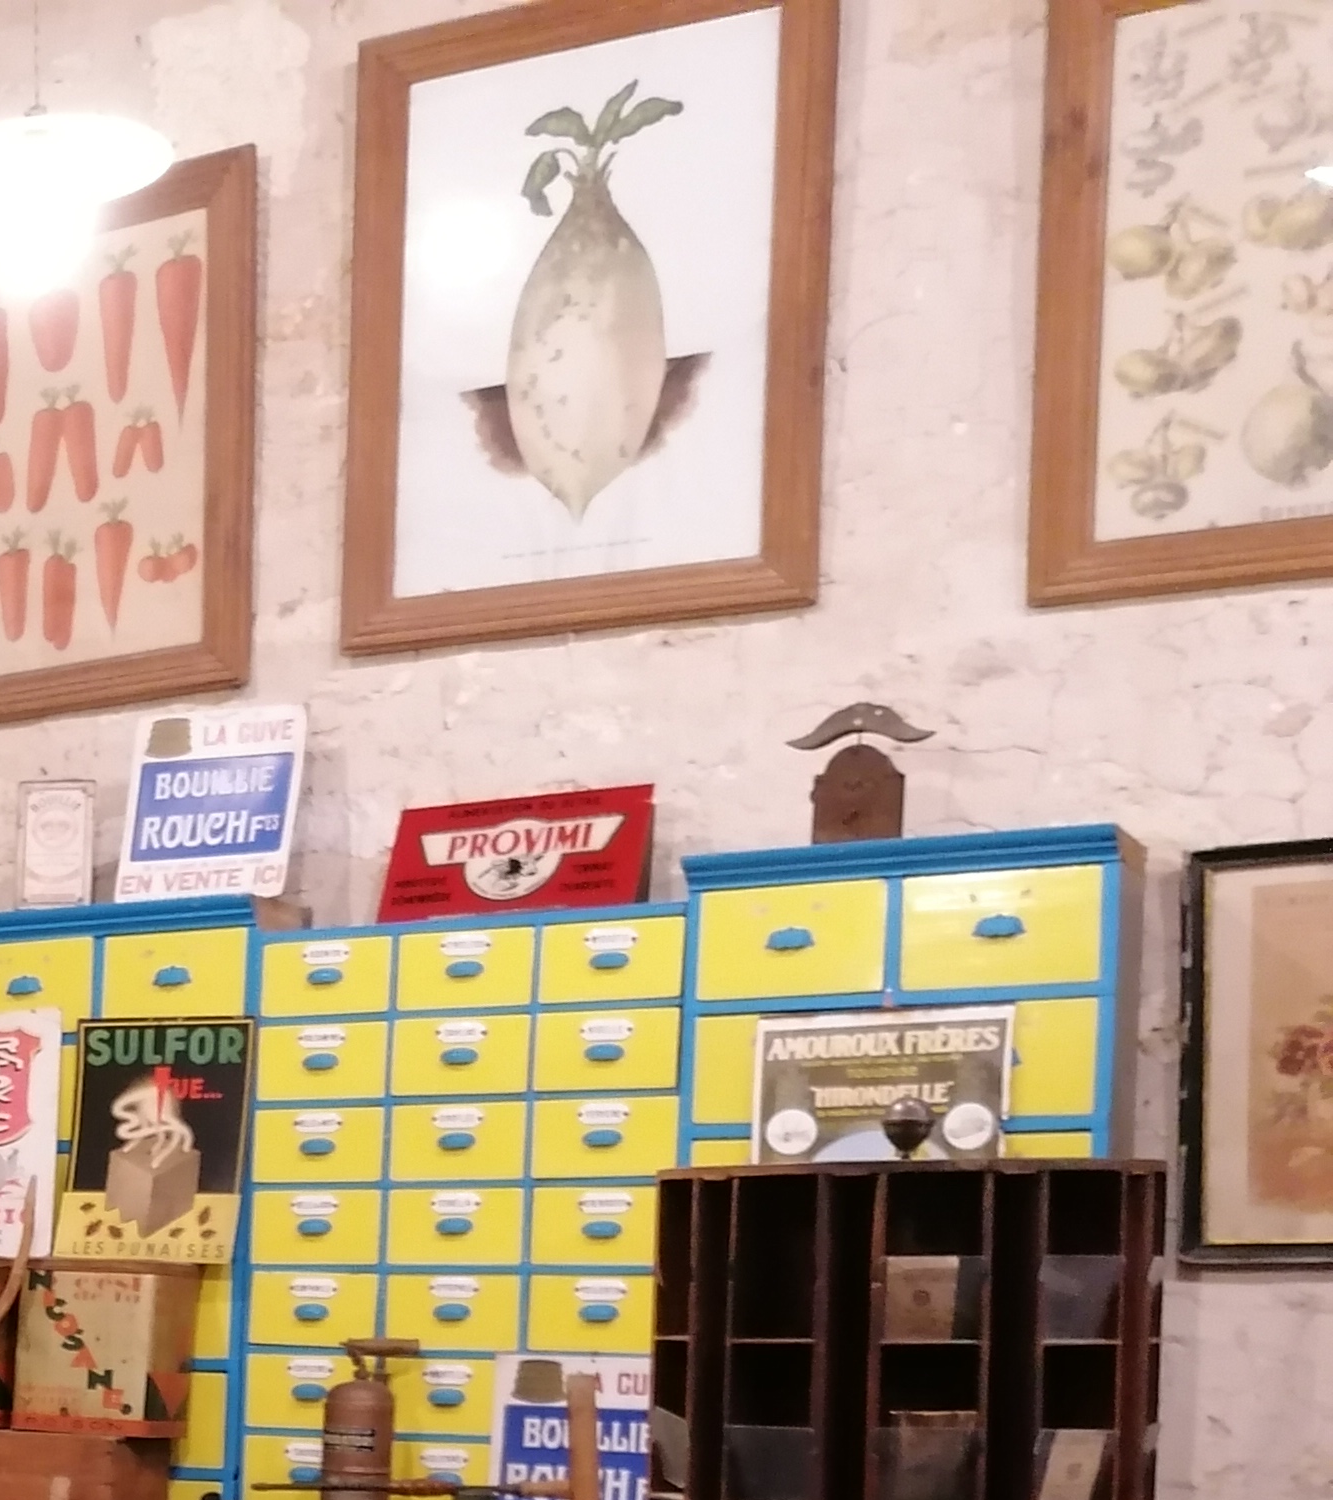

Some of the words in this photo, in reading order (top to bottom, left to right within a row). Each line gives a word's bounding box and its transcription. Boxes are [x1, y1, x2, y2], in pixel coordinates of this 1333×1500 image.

[203, 723, 226, 746] LA
[238, 719, 294, 744] CUVE
[155, 765, 274, 800] BOUILLIE
[140, 810, 248, 850] ROUCH
[448, 823, 593, 860] PROVIMI
[120, 874, 152, 895] EN
[164, 868, 244, 891] VENTE
[254, 865, 285, 885] ICI
[87, 1026, 245, 1066] SULFOR
[766, 1031, 901, 1061] AMOUROUX
[618, 1373, 649, 1396] CU
